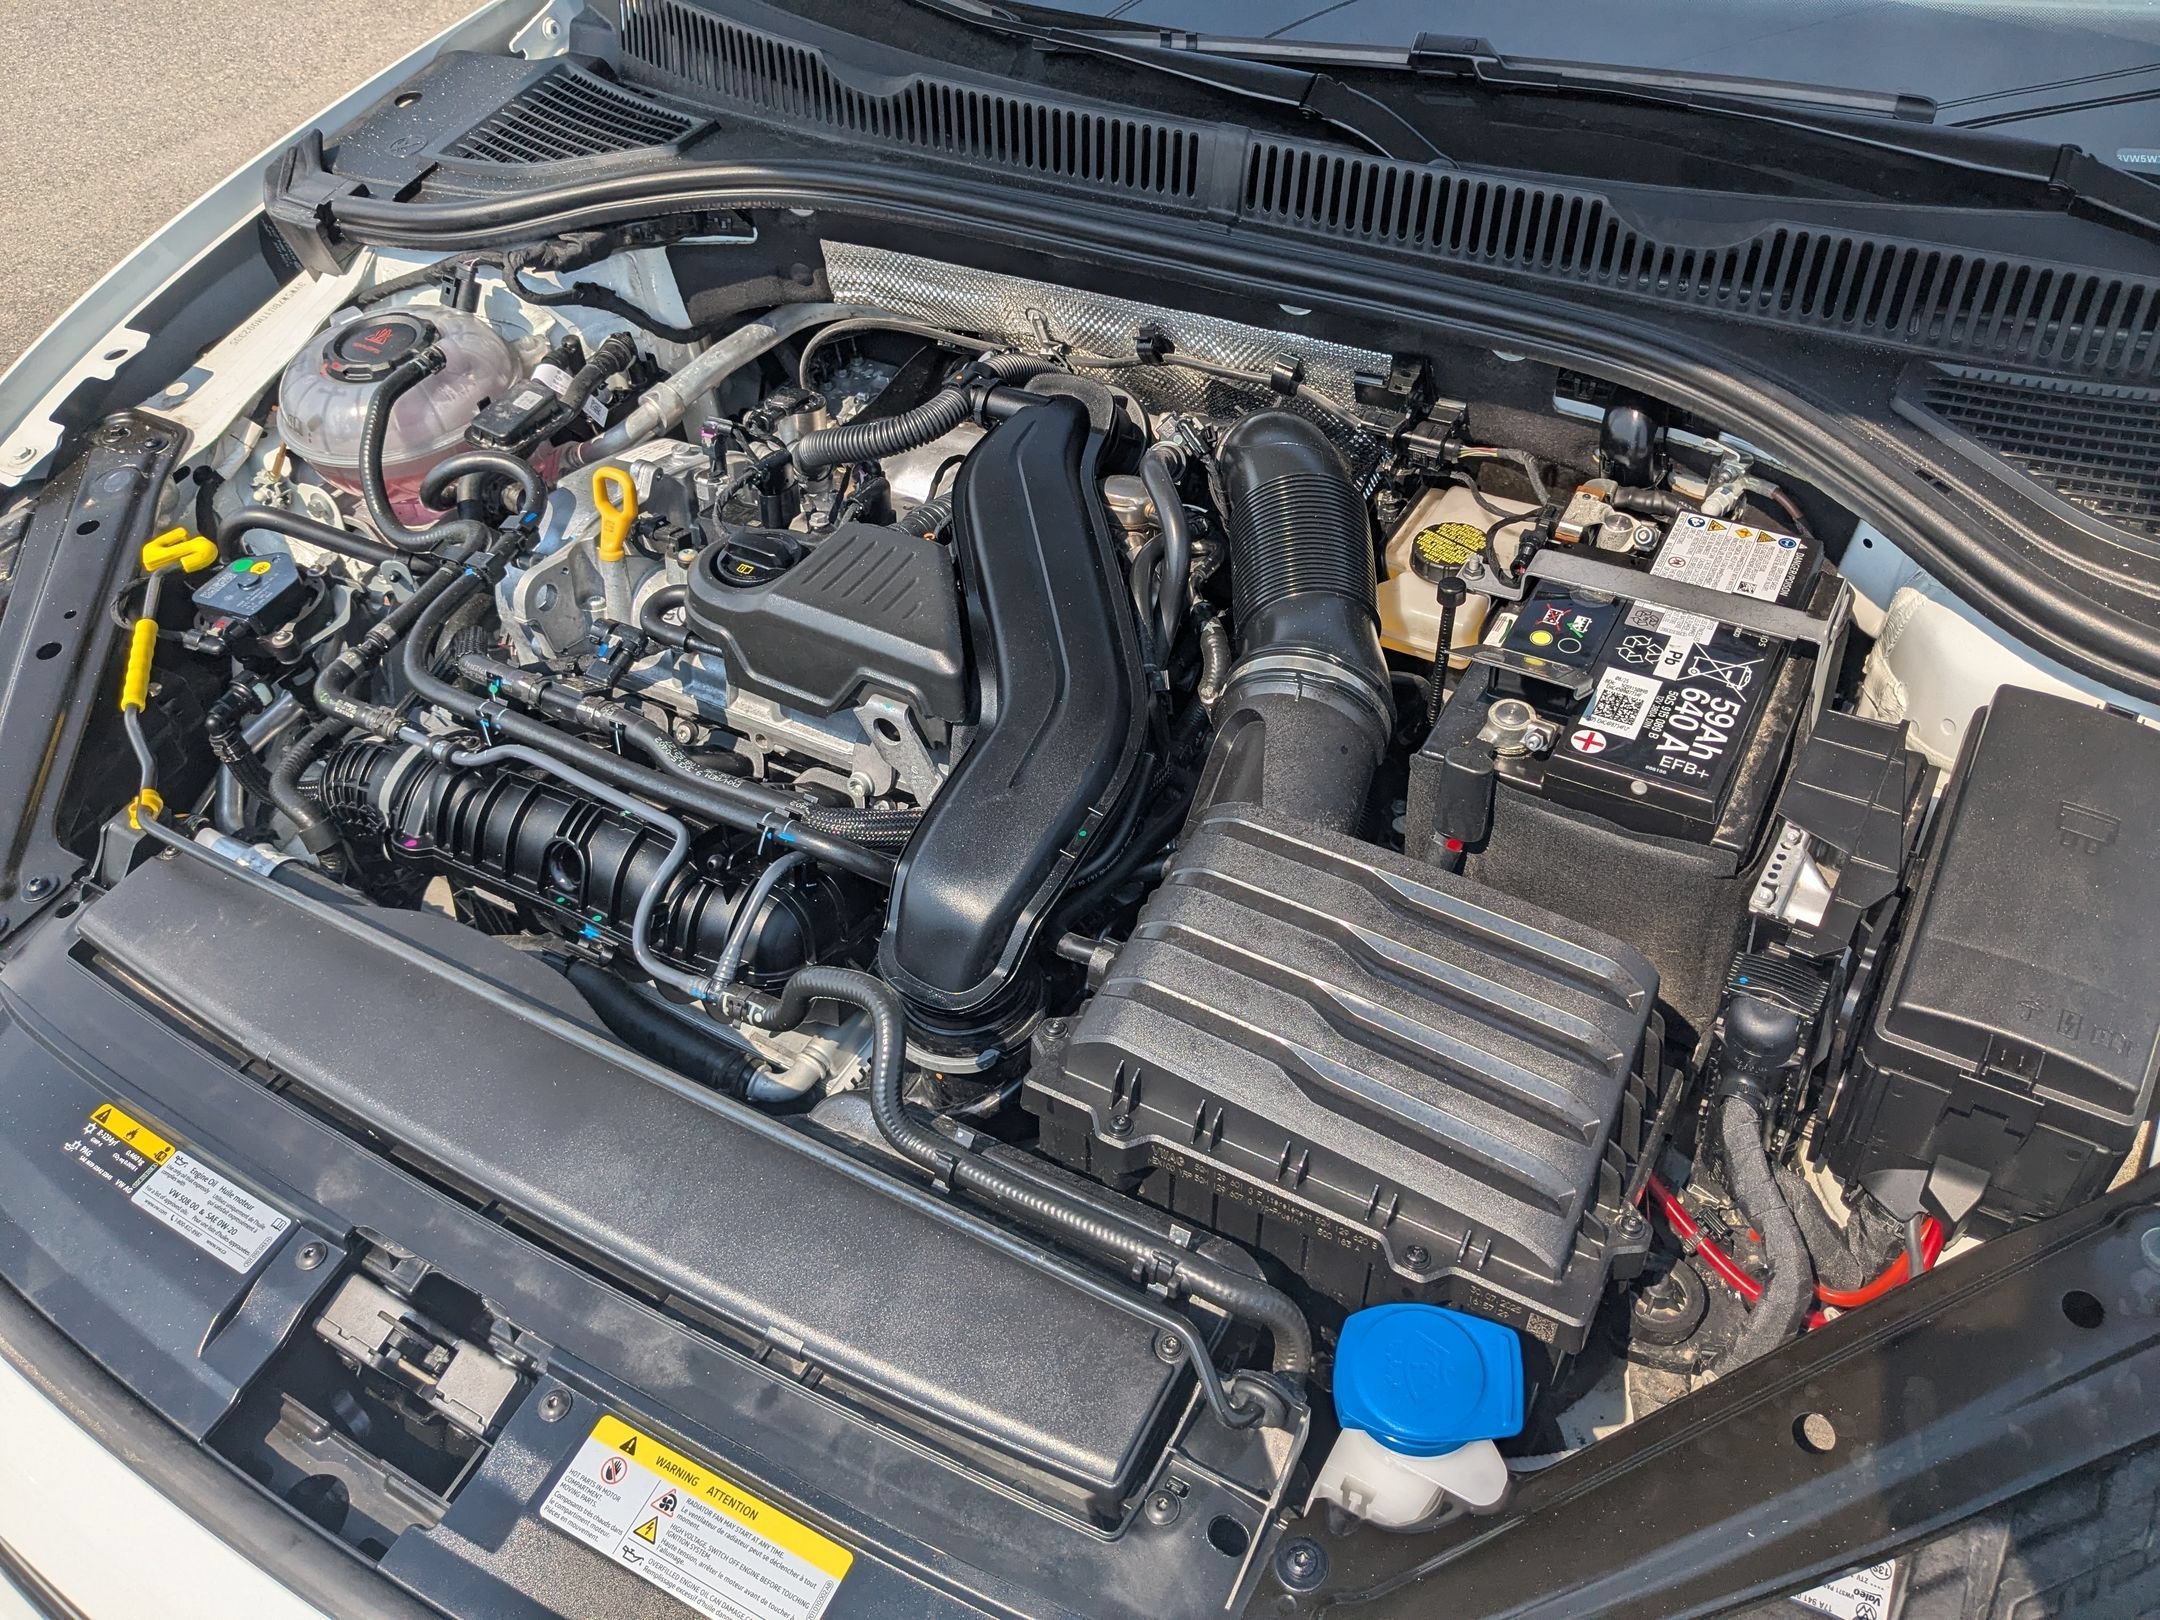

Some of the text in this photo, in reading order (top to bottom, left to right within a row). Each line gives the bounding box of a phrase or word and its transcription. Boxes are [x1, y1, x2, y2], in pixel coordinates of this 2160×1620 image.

[1662, 649, 1684, 667] Pb
[1647, 689, 1679, 740] 5QS 915 089 B
[1665, 684, 1713, 733] 640
[1654, 730, 1693, 757] A
[1686, 695, 1745, 763] 59Ah
[1659, 755, 1709, 778] EFB+
[78, 1144, 94, 1157] PAG
[135, 1157, 146, 1167] kg
[1147, 1154, 1176, 1172] MEXICO
[113, 1178, 126, 1189] VW
[122, 1184, 134, 1194] AG
[187, 1166, 256, 1211] Engine Oil Huile moteur
[167, 1187, 181, 1199] VW
[177, 1193, 192, 1206] 508
[188, 1201, 200, 1211] 00
[204, 1211, 219, 1224] SAE
[215, 1218, 238, 1236] 0W-20
[558, 1481, 599, 1508] MOVING PARTS.
[563, 1474, 604, 1501] COMPARTMENT.
[568, 1467, 621, 1502] HOT PARTS IN MOTOR
[653, 1454, 760, 1521] WARNING ATTENTION
[548, 1497, 556, 1505] le
[552, 1500, 591, 1528] compartiment
[552, 1489, 624, 1536] Composants très chauds dans
[675, 1512, 701, 1531] moment.
[685, 1497, 786, 1559] RADIATOR FAN MAY START AT ANY TIME.
[559, 1515, 568, 1523] en
[566, 1519, 601, 1542] mouvement.
[654, 1544, 686, 1567] l'allumage.
[665, 1529, 712, 1560] IGNITION SYSTEM.
[680, 1505, 689, 1514] Le
[686, 1509, 717, 1531] ventilateur
[715, 1526, 726, 1536] de
[723, 1530, 750, 1550] radiateur
[746, 1546, 763, 1559] peut
[760, 1554, 769, 1562] se
[767, 1557, 801, 1580] déclencher
[802, 1577, 817, 1590] tout
[659, 1537, 678, 1552] Haute
[675, 1547, 700, 1565] tension,
[697, 1559, 719, 1576] arrêter
[716, 1571, 725, 1579] le
[722, 1575, 745, 1591] moteur
[743, 1587, 761, 1601] avant
[759, 1596, 769, 1606] de
[766, 1601, 791, 1619] toucher
[669, 1522, 685, 1535] HIGH
[707, 1544, 730, 1561] SWITCH
[727, 1556, 741, 1568] OFF
[738, 1563, 761, 1580] ENGINE
[758, 1575, 782, 1592] BEFORE
[780, 1587, 811, 1609] TOUCHING
[1856, 1574, 1868, 1583] ZTV
[641, 1565, 716, 1613] Remplissage excessif d'huile
[646, 1557, 680, 1581] OVERFILLED
[678, 1576, 700, 1593] ENGINE
[698, 1588, 709, 1599] OIL
[707, 1594, 721, 1606] CAN
[719, 1601, 744, 1619] DAMAGE
[1853, 1588, 1880, 1606] Valeo
[1819, 1600, 1832, 1611] 17A
